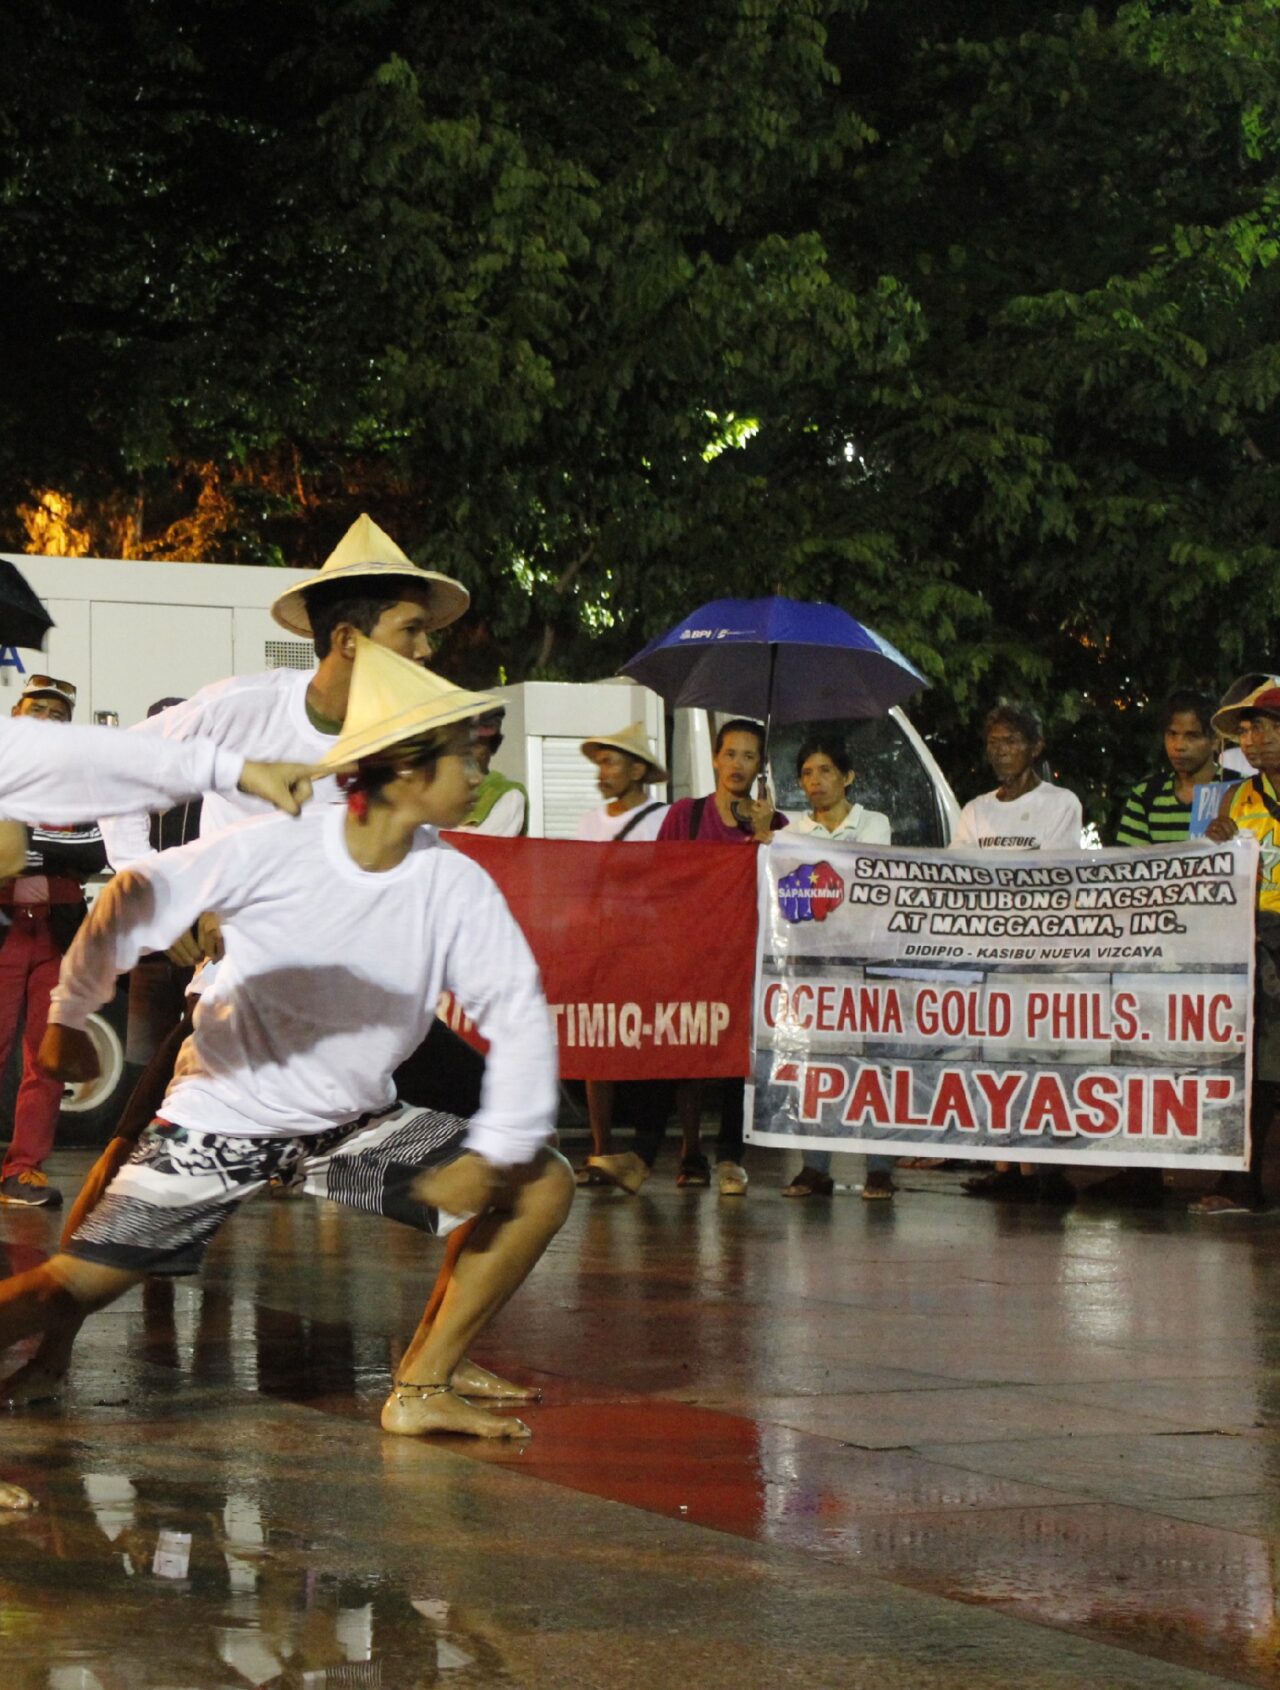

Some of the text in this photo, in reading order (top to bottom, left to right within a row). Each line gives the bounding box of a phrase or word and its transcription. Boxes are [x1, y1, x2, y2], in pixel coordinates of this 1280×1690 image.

[855, 852, 1234, 887] SAMAHANG PANG KARAPATAN
[849, 881, 1237, 910] NG KATUTUBONG MAGSASAKA
[888, 911, 1187, 938] AT MANGGAGAWA, INC.
[905, 945, 963, 958] DIDIPIO
[976, 947, 1036, 959] KASIBU
[1040, 947, 1091, 959] NUEVA
[1097, 946, 1163, 959] VIZCAYA
[548, 1000, 730, 1050] TIMIQ-KMP
[764, 983, 1244, 1042] OCEANA GOLD PHILS. INC.
